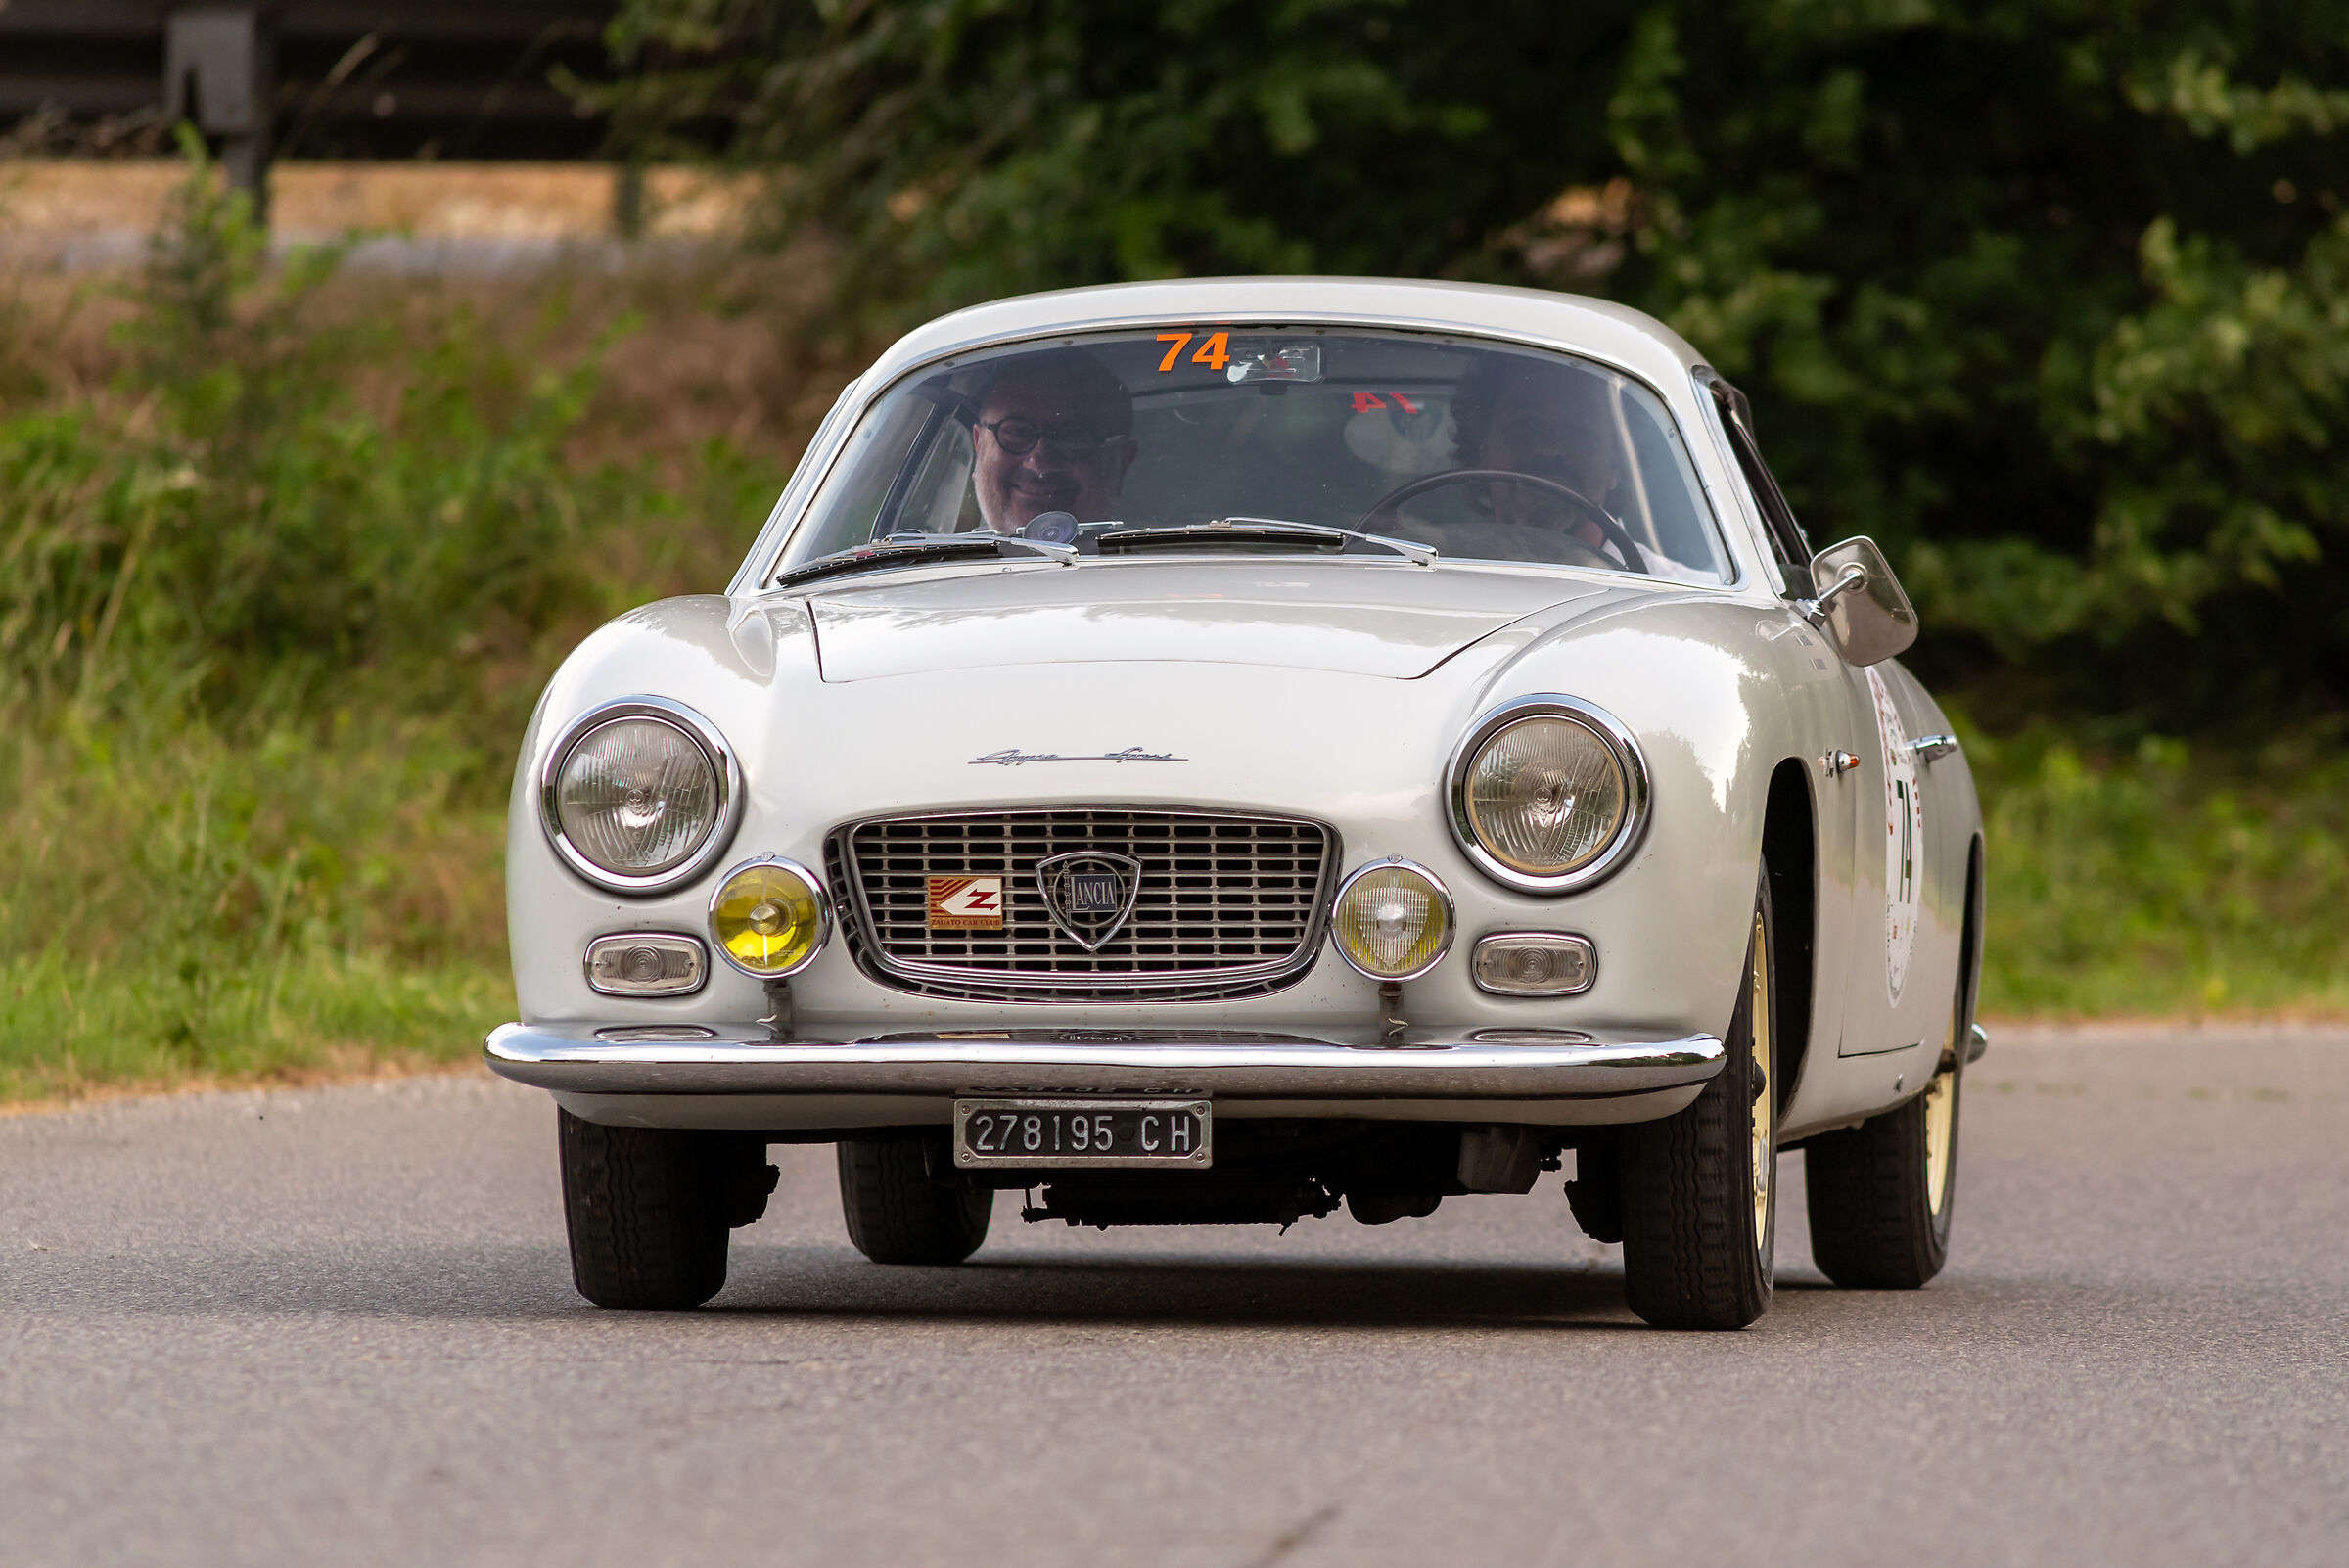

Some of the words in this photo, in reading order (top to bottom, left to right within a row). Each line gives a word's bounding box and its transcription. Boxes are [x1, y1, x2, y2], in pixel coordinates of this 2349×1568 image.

[1156, 332, 1230, 372] 74
[1071, 876, 1115, 911] LANCIA
[975, 1115, 1114, 1152] 278195
[1140, 1115, 1191, 1152] CH
